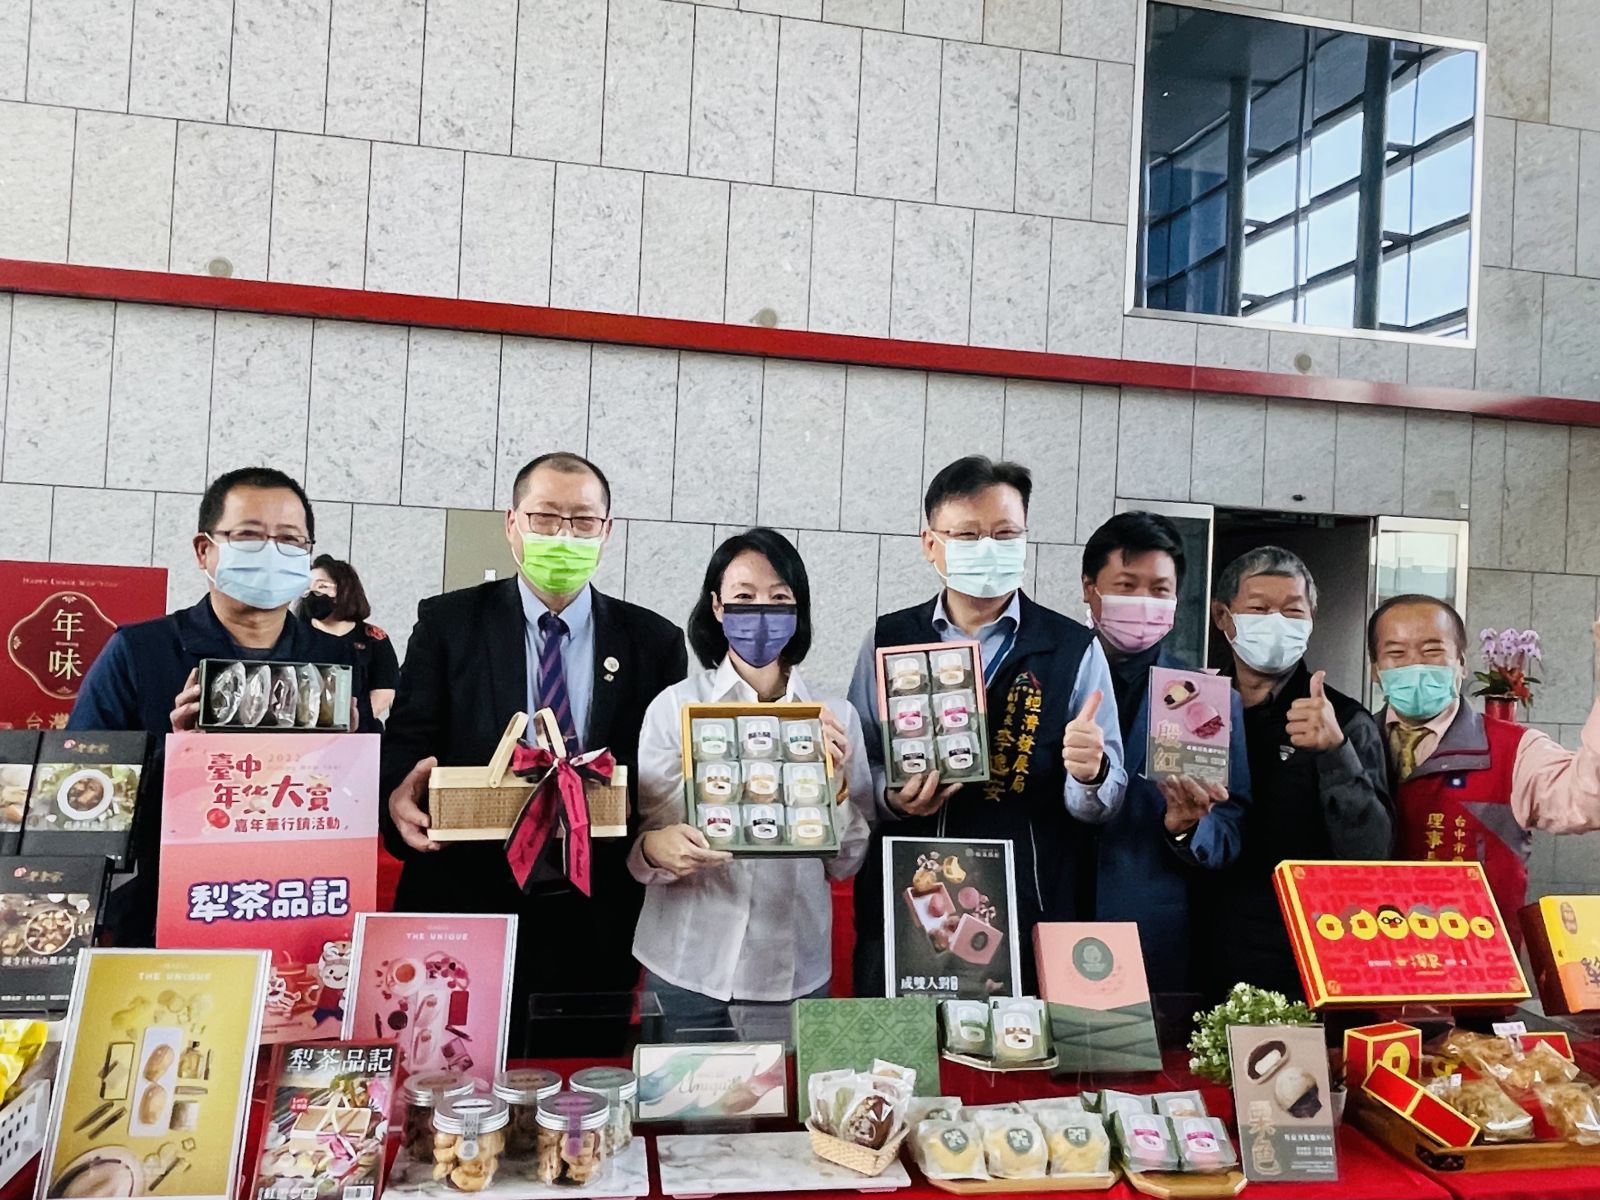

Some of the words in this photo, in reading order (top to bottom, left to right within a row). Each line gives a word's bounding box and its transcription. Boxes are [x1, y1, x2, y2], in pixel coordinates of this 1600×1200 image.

[48, 608, 86, 681] 年味
[207, 753, 262, 781] 臺中
[406, 932, 425, 940] THE
[430, 932, 469, 941] UNIQUE
[138, 971, 161, 981] THE
